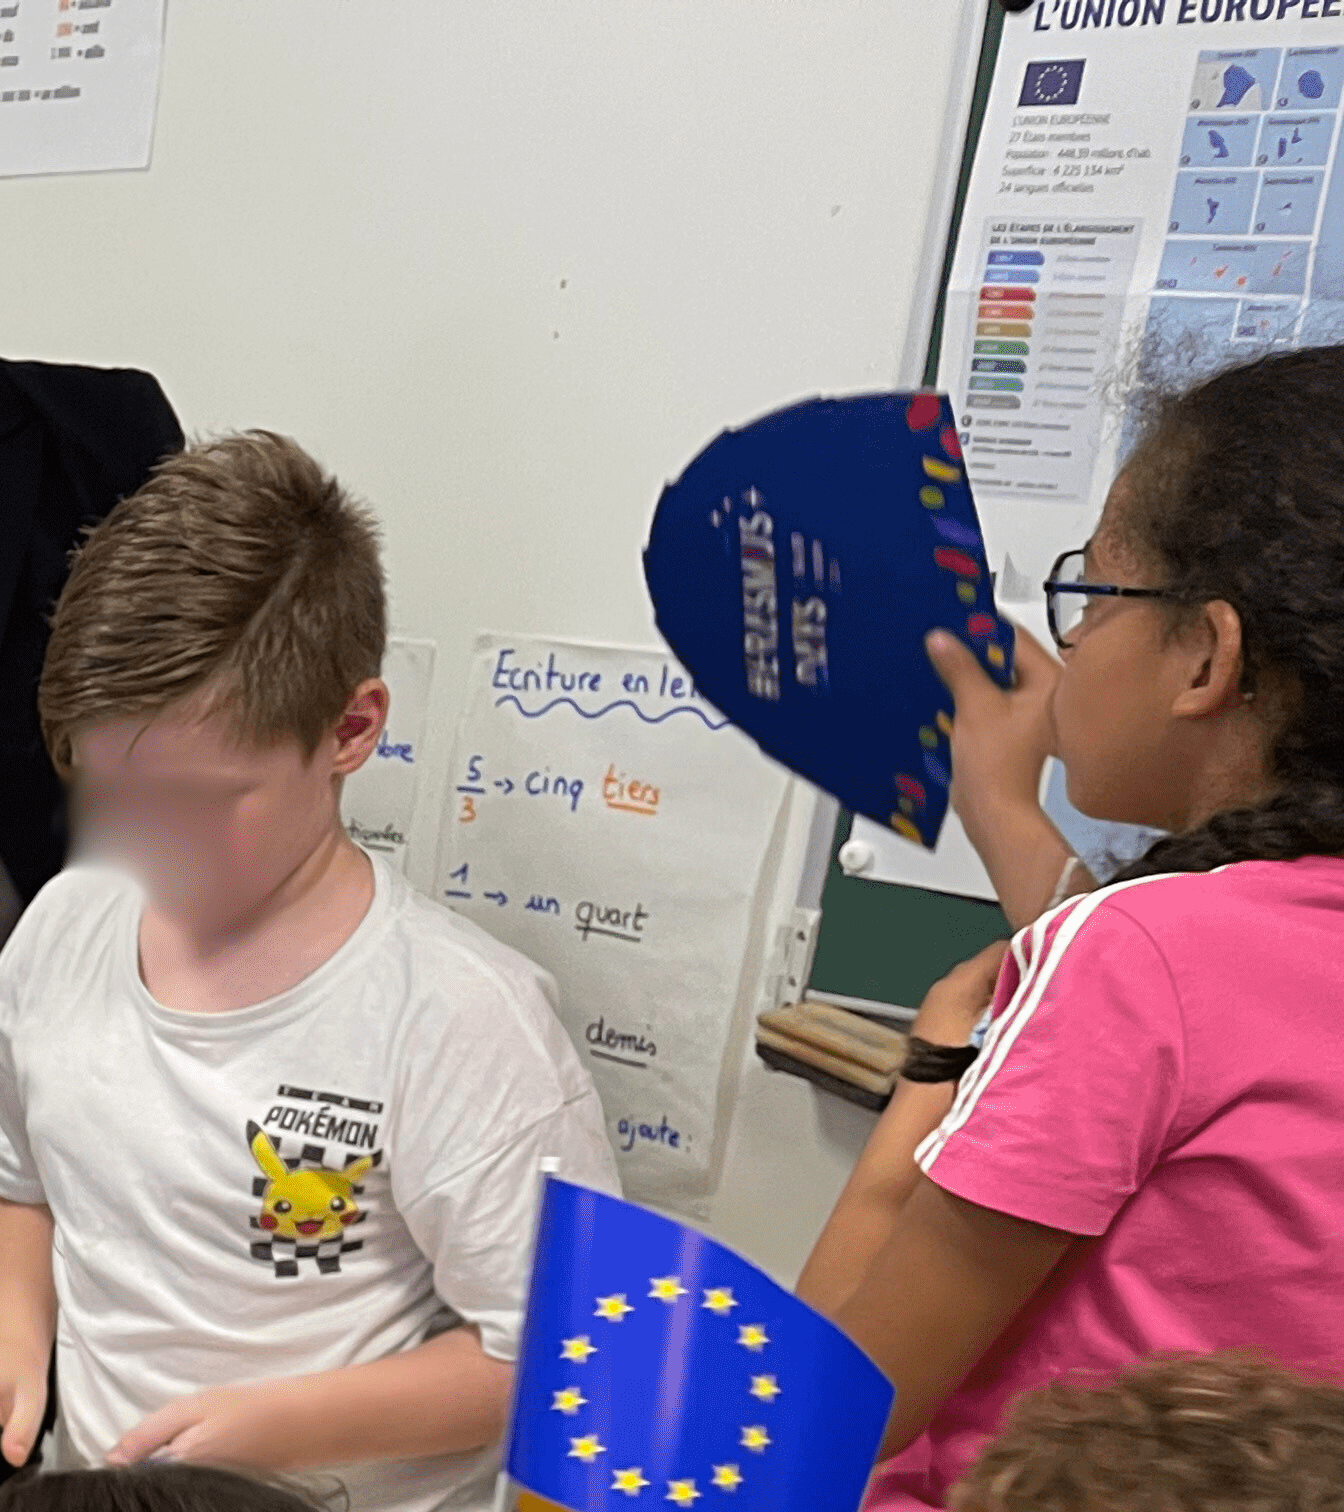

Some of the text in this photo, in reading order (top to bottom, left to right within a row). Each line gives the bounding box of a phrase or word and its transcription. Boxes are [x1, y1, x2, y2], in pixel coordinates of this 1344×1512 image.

[493, 649, 601, 694] Ecriture
[622, 672, 650, 697] en
[466, 755, 661, 812] 5 cinq tiers
[458, 800, 477, 823] 3
[449, 863, 649, 941] 1 un quart
[585, 1017, 657, 1056] demis
[263, 1105, 378, 1148] POKÉMON
